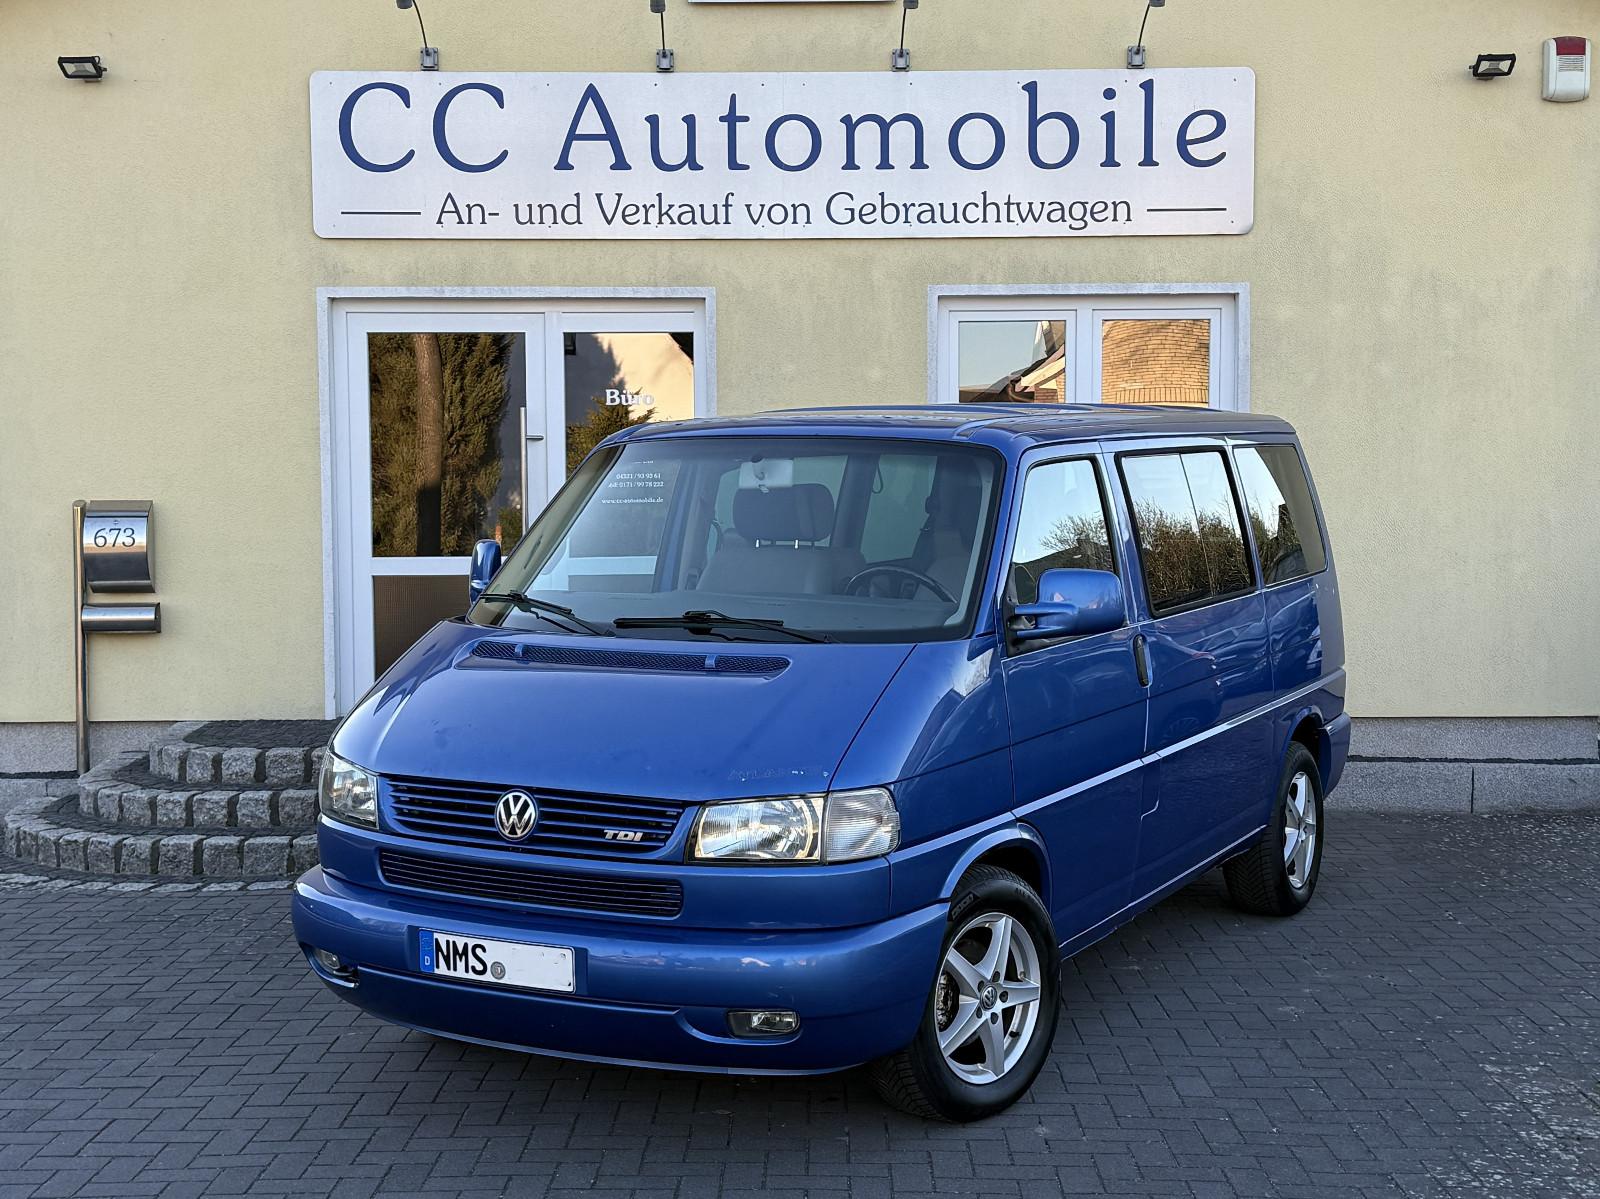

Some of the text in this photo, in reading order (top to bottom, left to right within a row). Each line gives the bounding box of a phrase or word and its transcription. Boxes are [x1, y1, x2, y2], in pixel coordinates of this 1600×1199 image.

[338, 78, 1227, 174] CC Automobile
[435, 190, 1133, 231] An- und Verkauf von Gebrauchtwagen
[605, 388, 655, 406] Büro
[93, 527, 136, 548] 673
[603, 829, 644, 842] TDI
[434, 937, 488, 976] NMS
